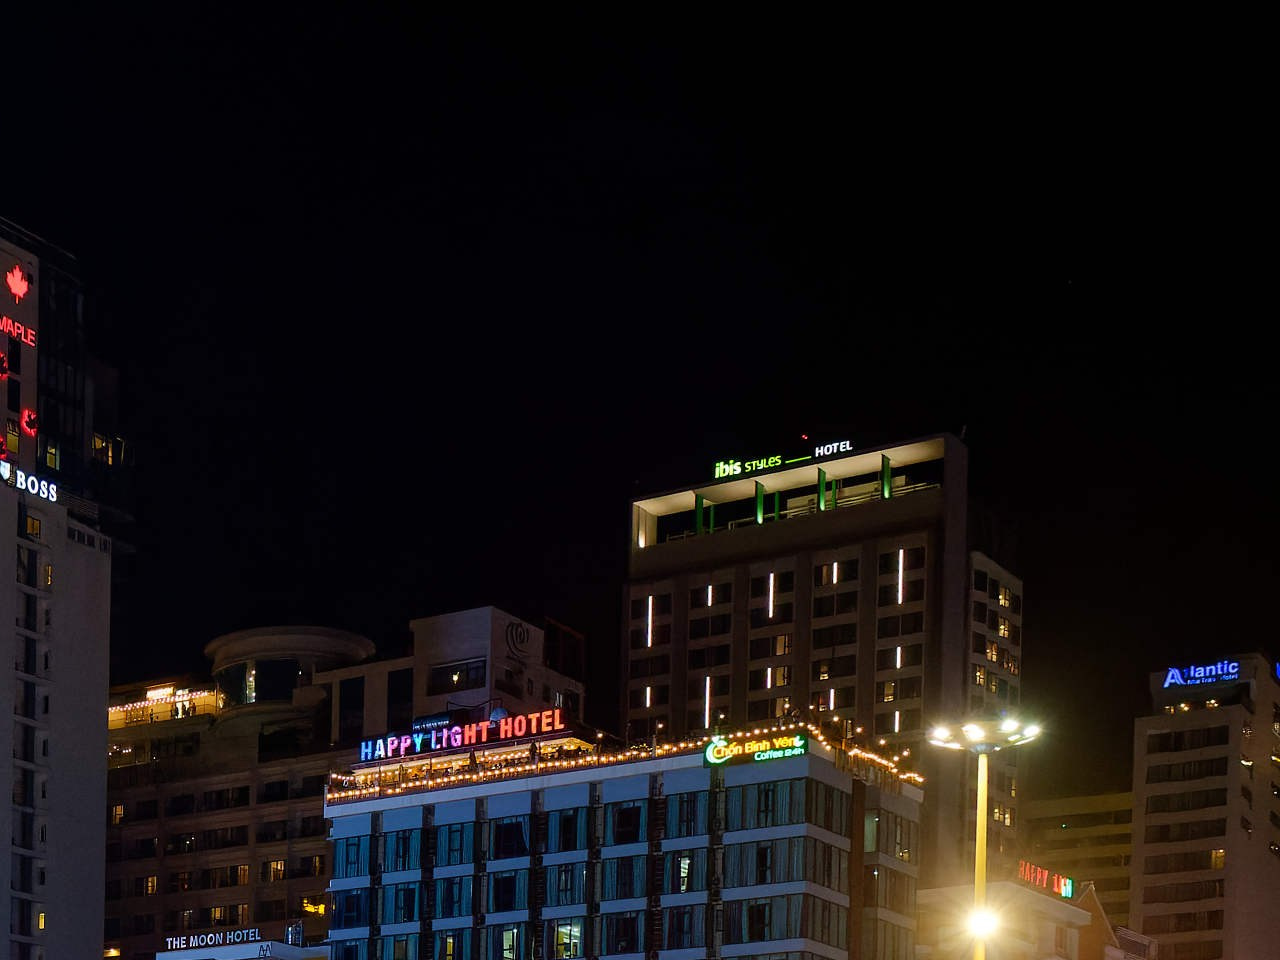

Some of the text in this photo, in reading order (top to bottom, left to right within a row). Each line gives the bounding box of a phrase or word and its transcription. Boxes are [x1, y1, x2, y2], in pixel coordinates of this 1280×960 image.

[714, 459, 742, 479] ibis
[815, 440, 853, 457] HOTEL
[16, 469, 57, 502] BOSS
[1163, 660, 1239, 688] Atlantic
[360, 708, 565, 761] HAPPY LIGHT HOTEL
[754, 750, 783, 760] Coffee
[166, 928, 261, 950] THE MOON HOTEL
